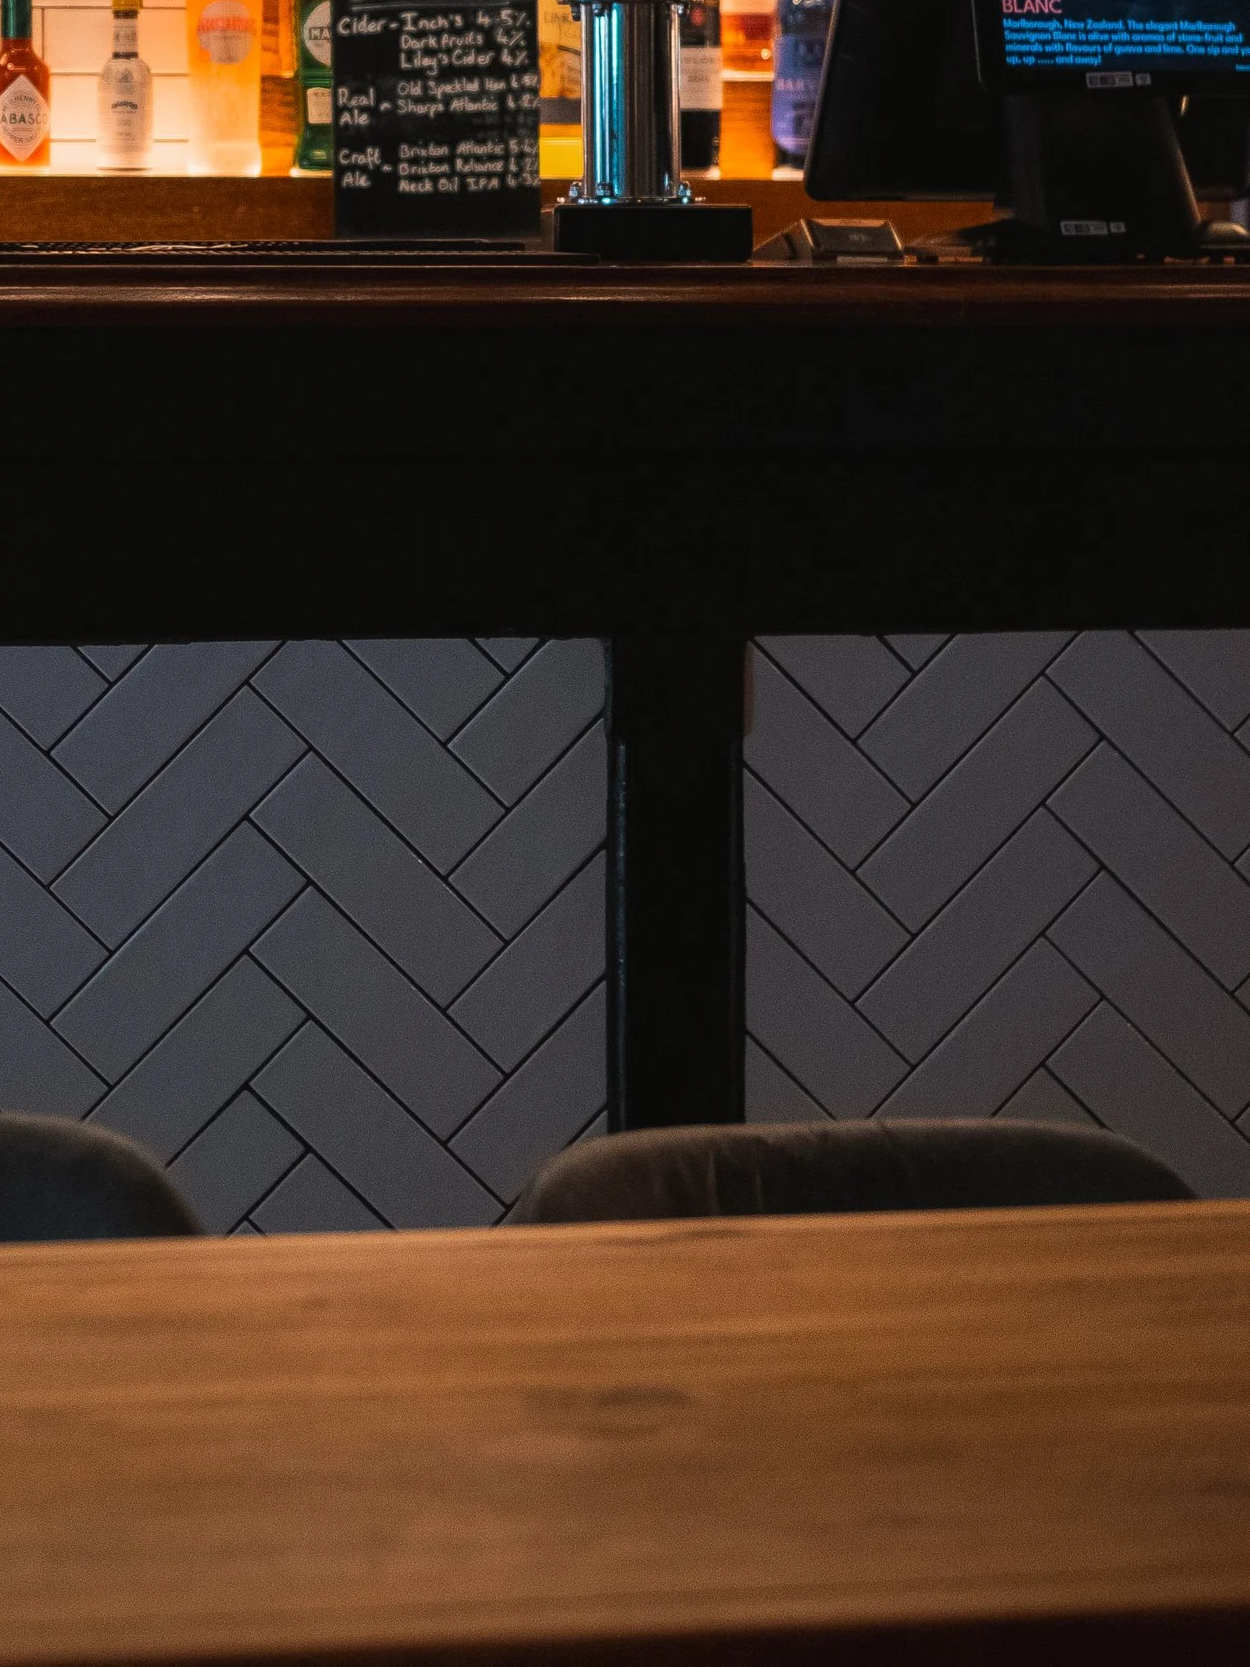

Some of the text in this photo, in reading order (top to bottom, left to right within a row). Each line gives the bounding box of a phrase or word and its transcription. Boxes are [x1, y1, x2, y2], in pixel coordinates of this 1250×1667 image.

[337, 14, 387, 35] Cider
[1064, 18, 1084, 30] New
[1127, 19, 1144, 30] The
[401, 34, 439, 49] Dark
[1144, 44, 1162, 54] and
[1185, 44, 1205, 55] One
[451, 48, 495, 65] Cider
[398, 80, 423, 96] Old
[450, 95, 499, 111] Atlantic
[339, 109, 370, 127] Ale
[456, 139, 505, 156] Atlantic
[338, 146, 382, 171] Craft
[341, 170, 372, 189] Ale
[398, 178, 434, 193] Neck
[438, 175, 459, 192] Oil
[465, 177, 500, 190] IPA
